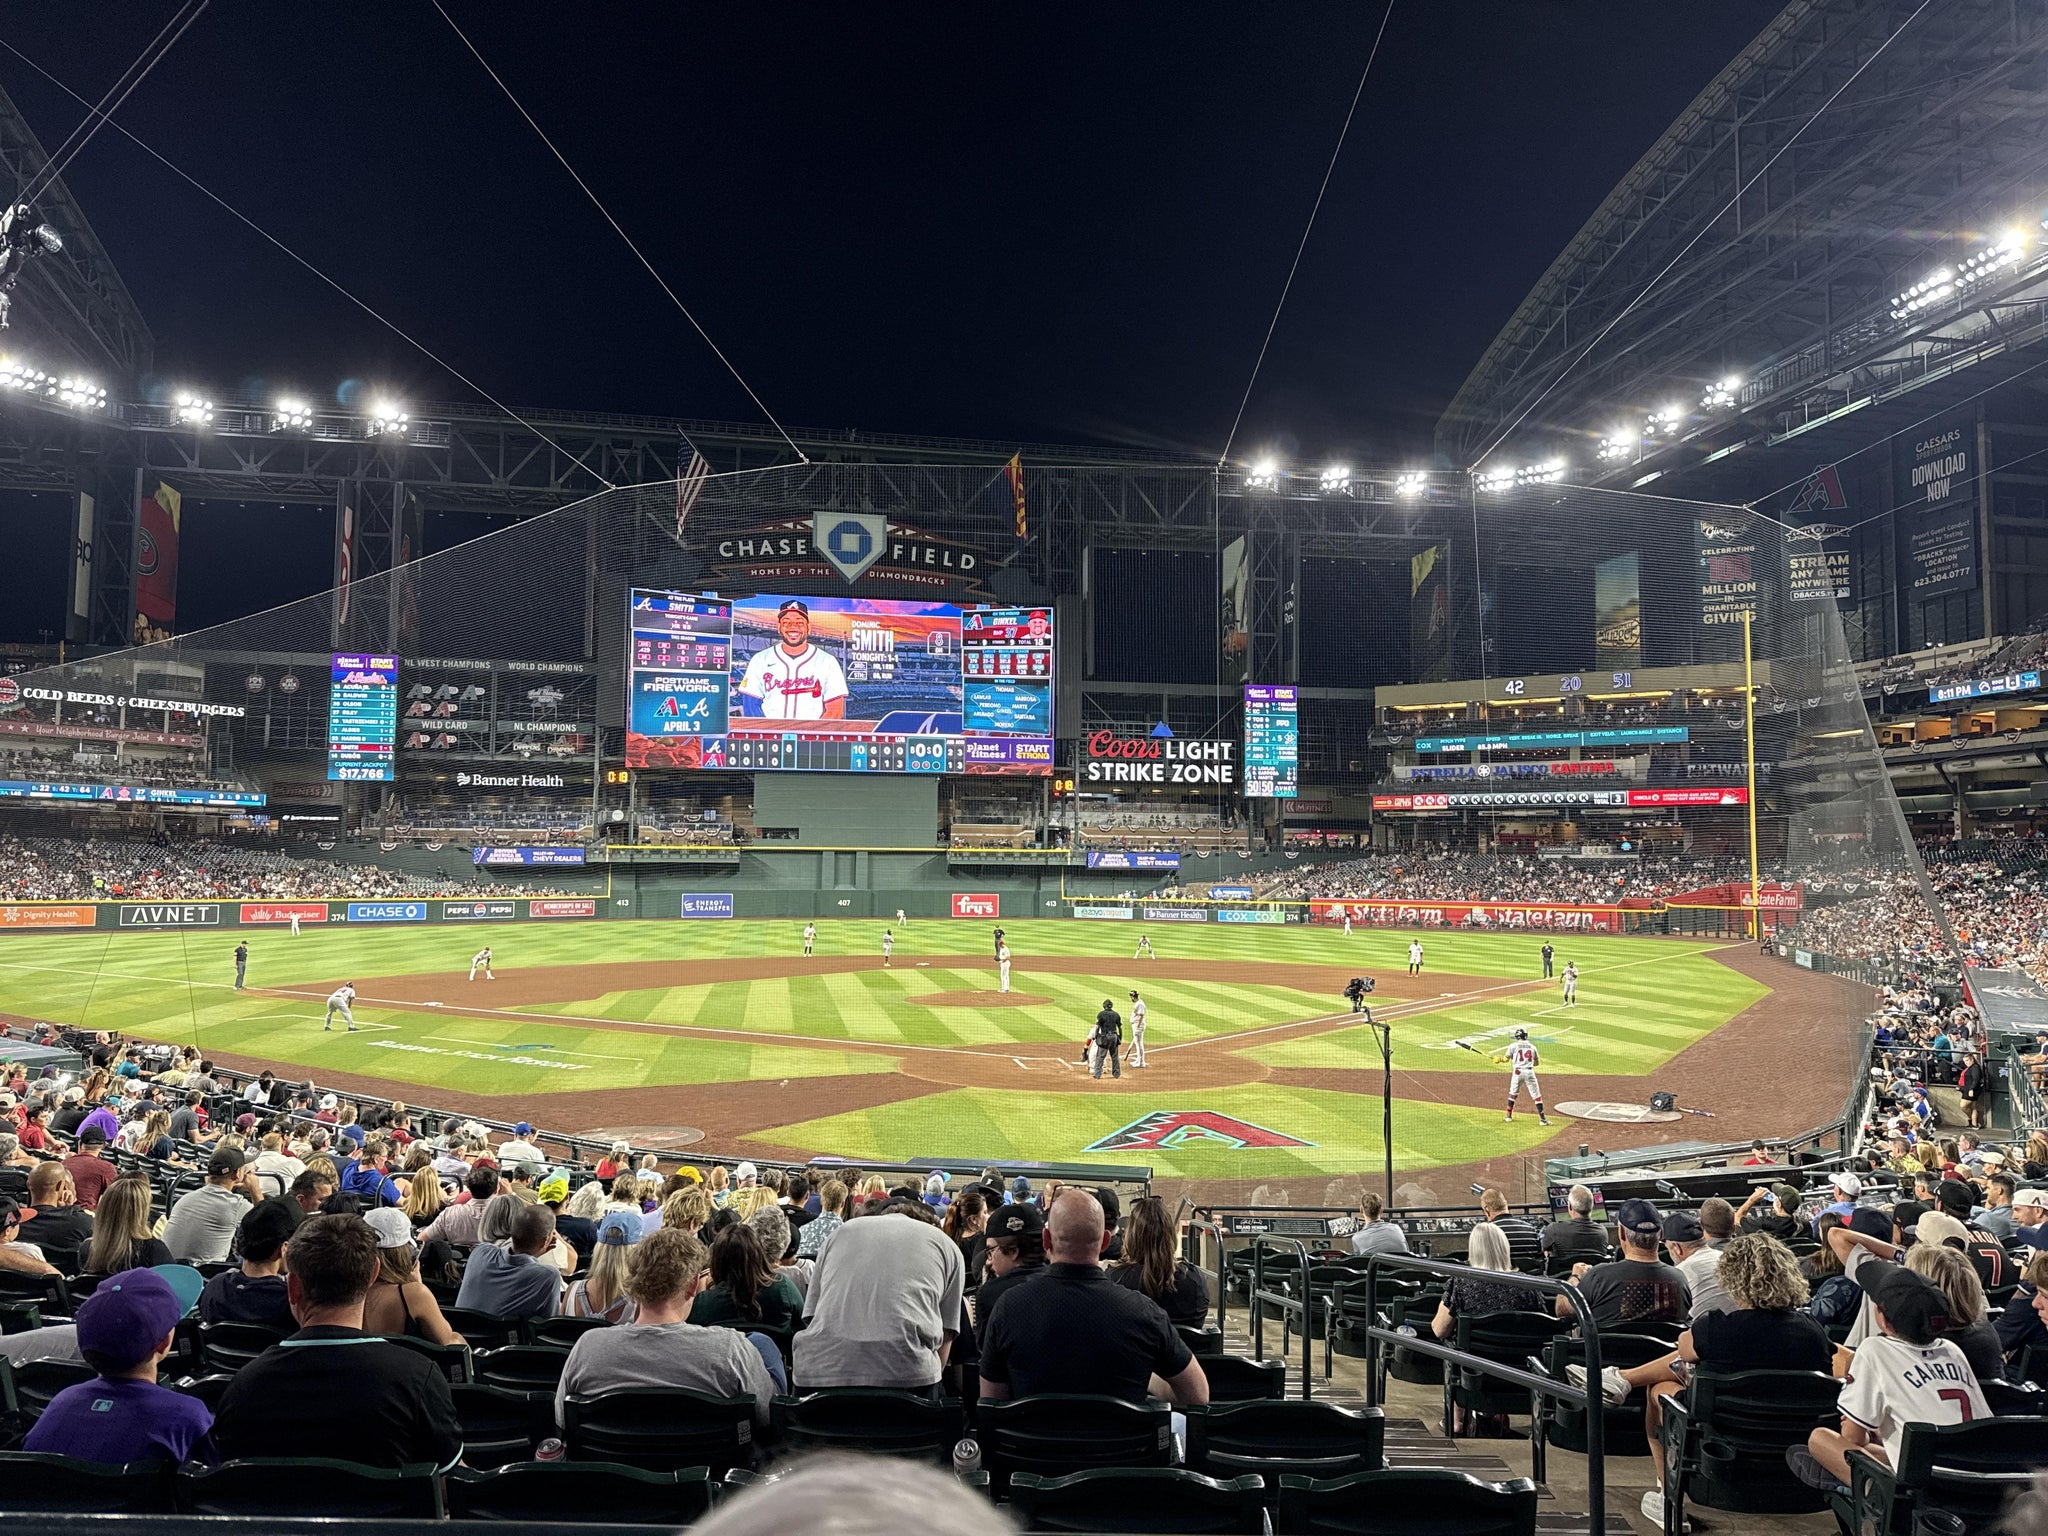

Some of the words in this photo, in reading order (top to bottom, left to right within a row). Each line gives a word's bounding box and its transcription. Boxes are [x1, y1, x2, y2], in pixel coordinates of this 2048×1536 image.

[1916, 429, 1960, 452] CAESARS
[1912, 452, 1966, 487] DOWNLOAD
[1927, 478, 1950, 502] NOW
[1930, 526, 1946, 536] Guest
[1947, 519, 1970, 531] Conduct
[719, 539, 807, 558] CHASE
[894, 544, 975, 569] FIELD
[1702, 546, 1755, 555] CELEBRATING
[1790, 555, 1849, 568] STREAM
[1925, 554, 1958, 567] LOCATION
[869, 571, 945, 585] DIAMONDBACKS
[1790, 570, 1813, 579] ANY
[1817, 568, 1849, 577] GAME
[1914, 567, 1970, 588] 623.304.0777
[1703, 583, 1756, 594] MILLION
[1790, 578, 1849, 589] ANYWHERE
[669, 603, 694, 612] SMITH
[1703, 603, 1756, 612] CHARITABLE
[1005, 627, 1017, 638] 37
[852, 629, 894, 652] SMITH
[935, 633, 944, 646] 8
[852, 652, 887, 661] TONIGHT:
[442, 661, 490, 669] CHAMPIONS
[537, 663, 583, 672] CHAMPIONS
[644, 683, 719, 693] FIREWORKS
[763, 672, 814, 692] Braves
[1505, 680, 1524, 694] 42
[1560, 676, 1582, 691] 20
[1613, 672, 1632, 688] 51
[1938, 689, 1954, 699] 8:11
[1956, 685, 1971, 697] PM
[23, 688, 63, 700] COLD
[67, 691, 114, 705] BEERS
[117, 697, 126, 707] &
[129, 698, 245, 716] CHEESEBURGERS
[664, 721, 691, 731] APRIL
[36, 725, 53, 735] Your
[56, 727, 103, 738] Neighborhood
[132, 732, 150, 741] Joint
[853, 745, 865, 754] 10
[916, 744, 926, 757] 0
[932, 744, 943, 758] 0
[967, 743, 999, 753] planet
[1088, 730, 1162, 758] Coors
[1166, 742, 1232, 760] LIGHT
[971, 750, 1006, 759] fitness
[339, 767, 384, 779] $17,766
[1088, 762, 1164, 781] STRIKE
[1172, 764, 1232, 783] ZONE
[1410, 767, 1475, 777] ESTRELLA
[1492, 765, 1548, 776] JALISCO
[1551, 762, 1613, 774] CANTINA
[473, 774, 518, 786] Banner
[522, 775, 563, 786] Health
[608, 772, 628, 783] 0:18
[1248, 781, 1258, 792] 50
[1262, 781, 1273, 792] 50
[957, 896, 993, 914] fry's
[24, 911, 50, 920] Dignity
[132, 907, 209, 922] AVNET
[358, 907, 403, 917] CHASE
[1255, 913, 1277, 921] COX
[1518, 1050, 1532, 1062] 14
[1978, 1249, 2001, 1286] 7
[1904, 1363, 1974, 1389] CARROLL
[1937, 1389, 1973, 1422] 7
